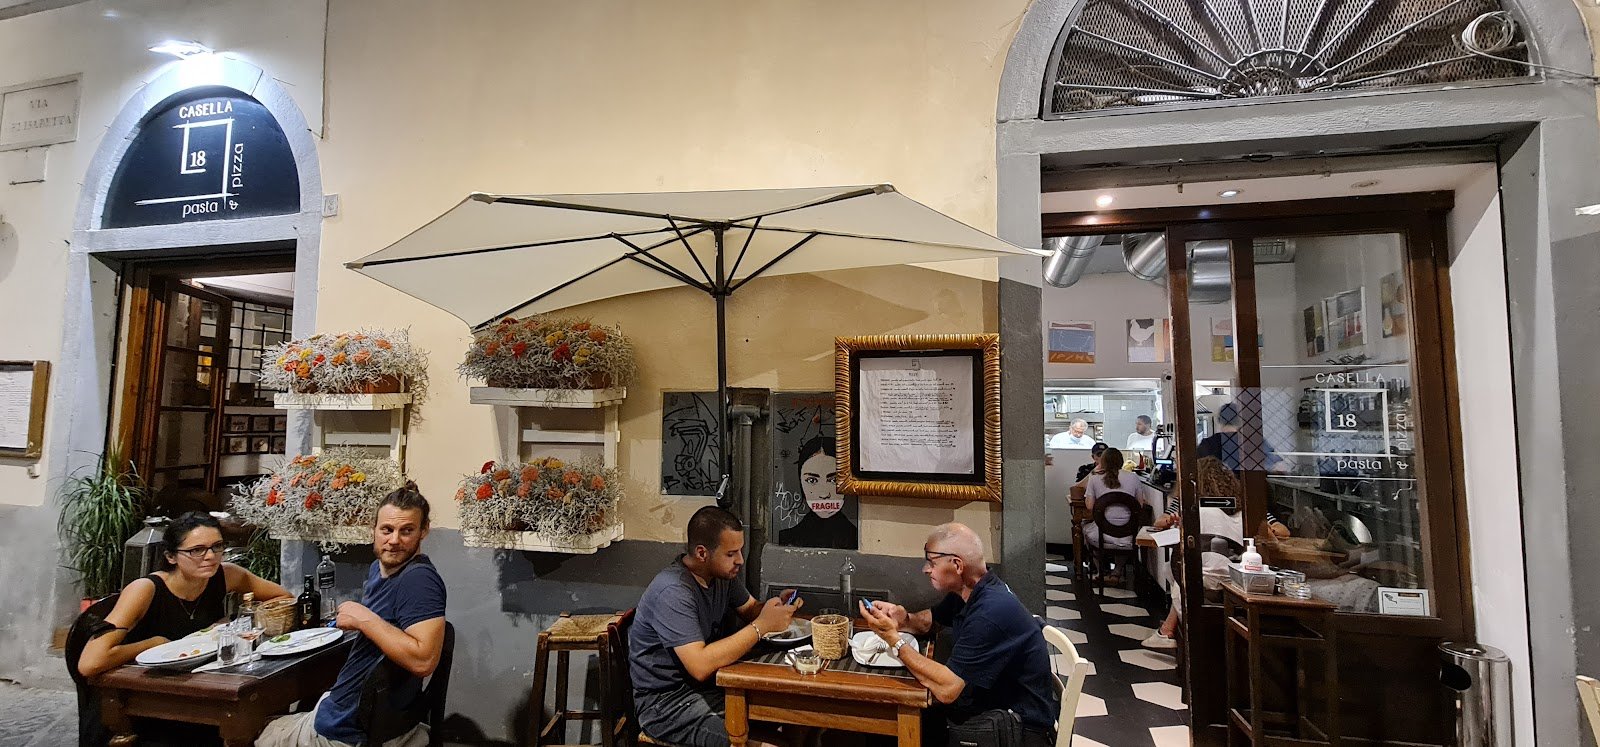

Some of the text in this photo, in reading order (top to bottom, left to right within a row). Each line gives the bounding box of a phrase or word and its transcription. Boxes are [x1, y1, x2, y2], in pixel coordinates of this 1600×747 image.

[179, 100, 233, 119] CASELLA
[190, 150, 206, 167] 18
[231, 143, 244, 188] pizza
[182, 200, 219, 218] pasta
[1315, 372, 1386, 383] CASELLA
[1337, 413, 1357, 428] 18
[1395, 413, 1412, 451] pizza
[1337, 459, 1382, 472] pasta
[811, 502, 840, 510] FRAGILE
